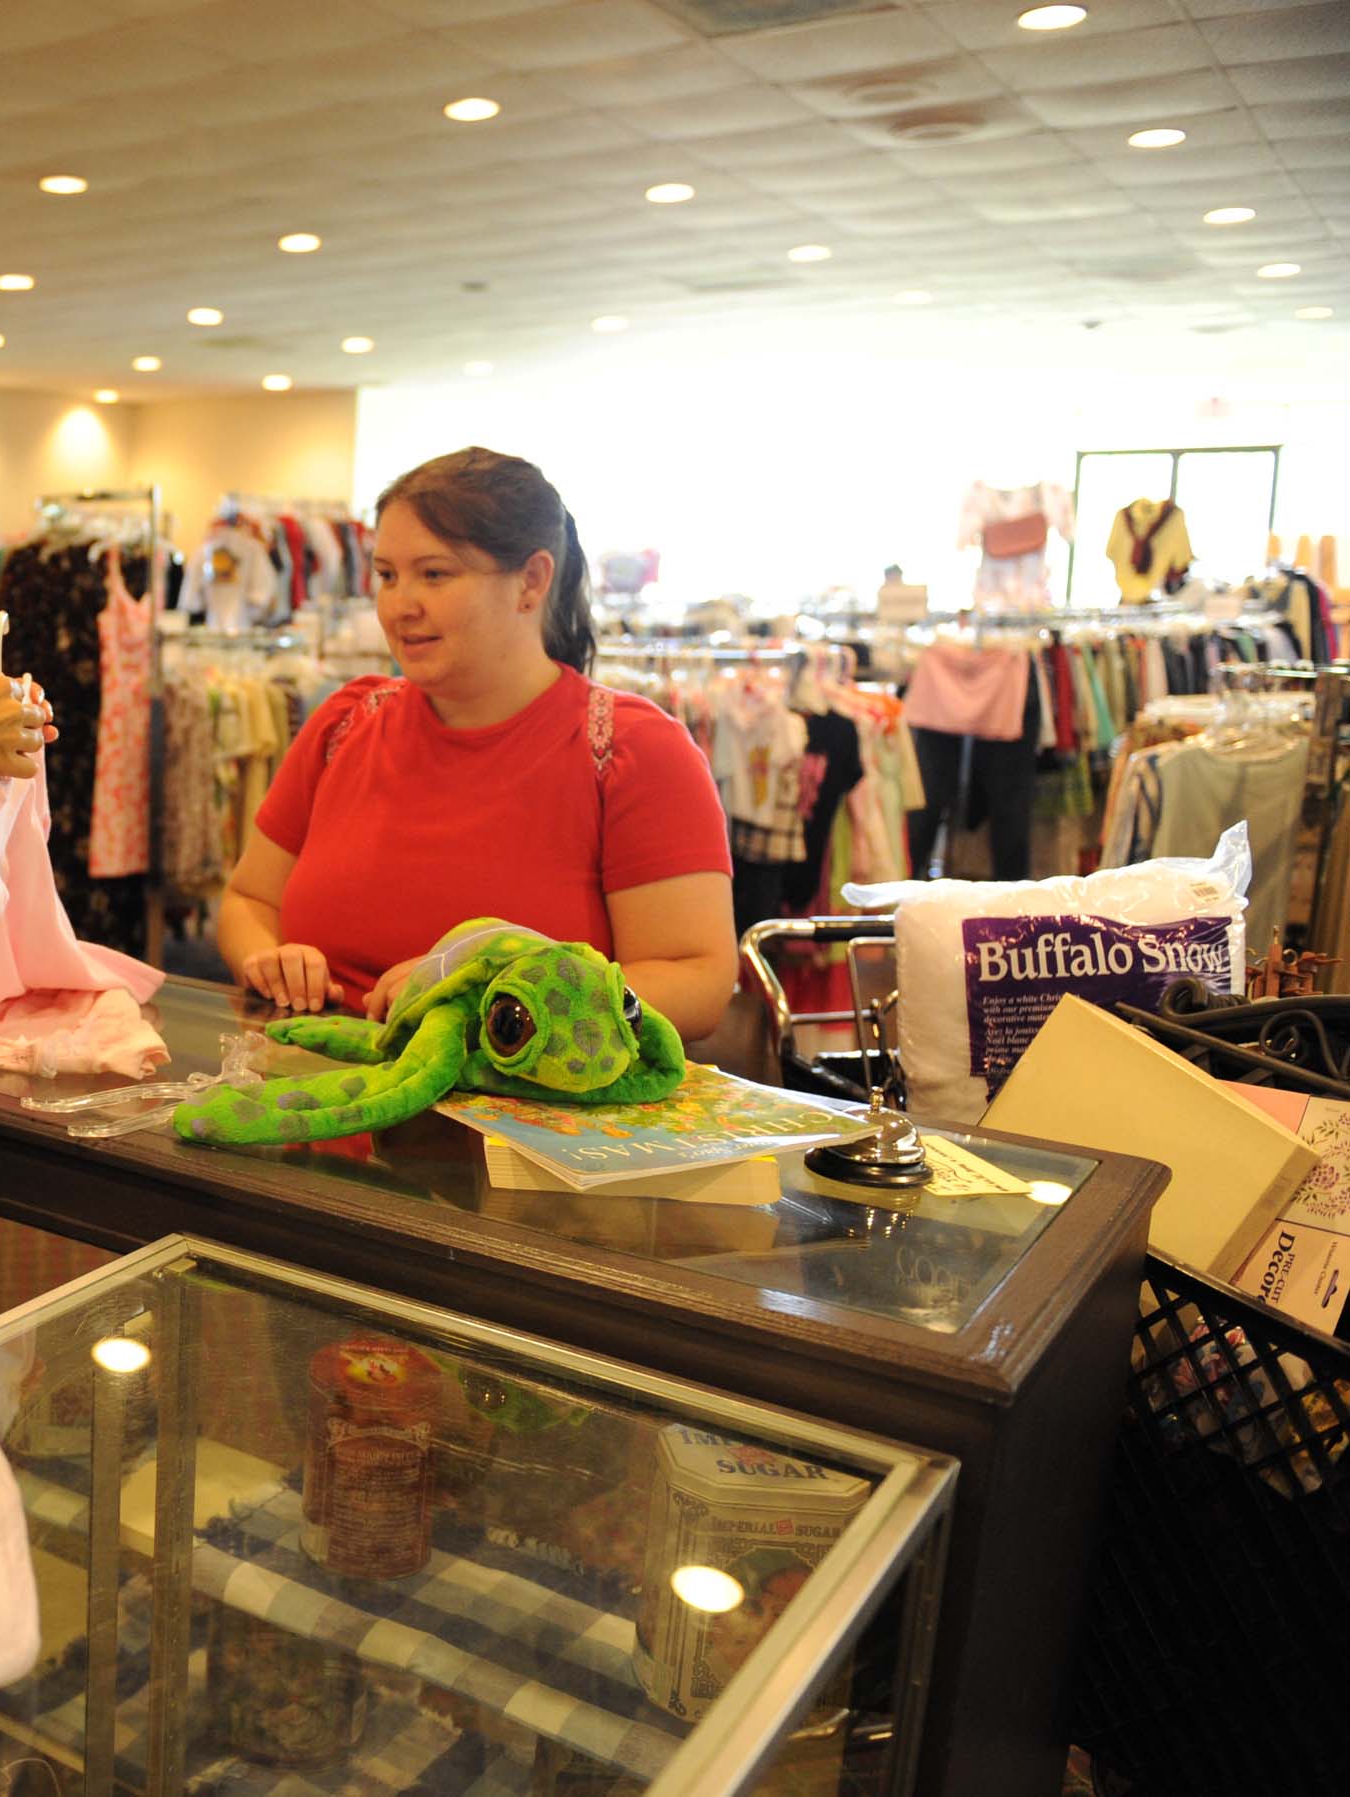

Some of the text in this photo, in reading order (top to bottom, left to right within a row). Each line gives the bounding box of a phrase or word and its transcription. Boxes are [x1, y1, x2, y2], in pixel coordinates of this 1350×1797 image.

[976, 932, 1229, 983] Buffalo Snow
[1016, 993, 1038, 1004] white
[562, 1111, 834, 1161] CHRISTMAS!
[1270, 1252, 1296, 1304] PRE-CUT
[715, 1458, 828, 1480] SUGAR
